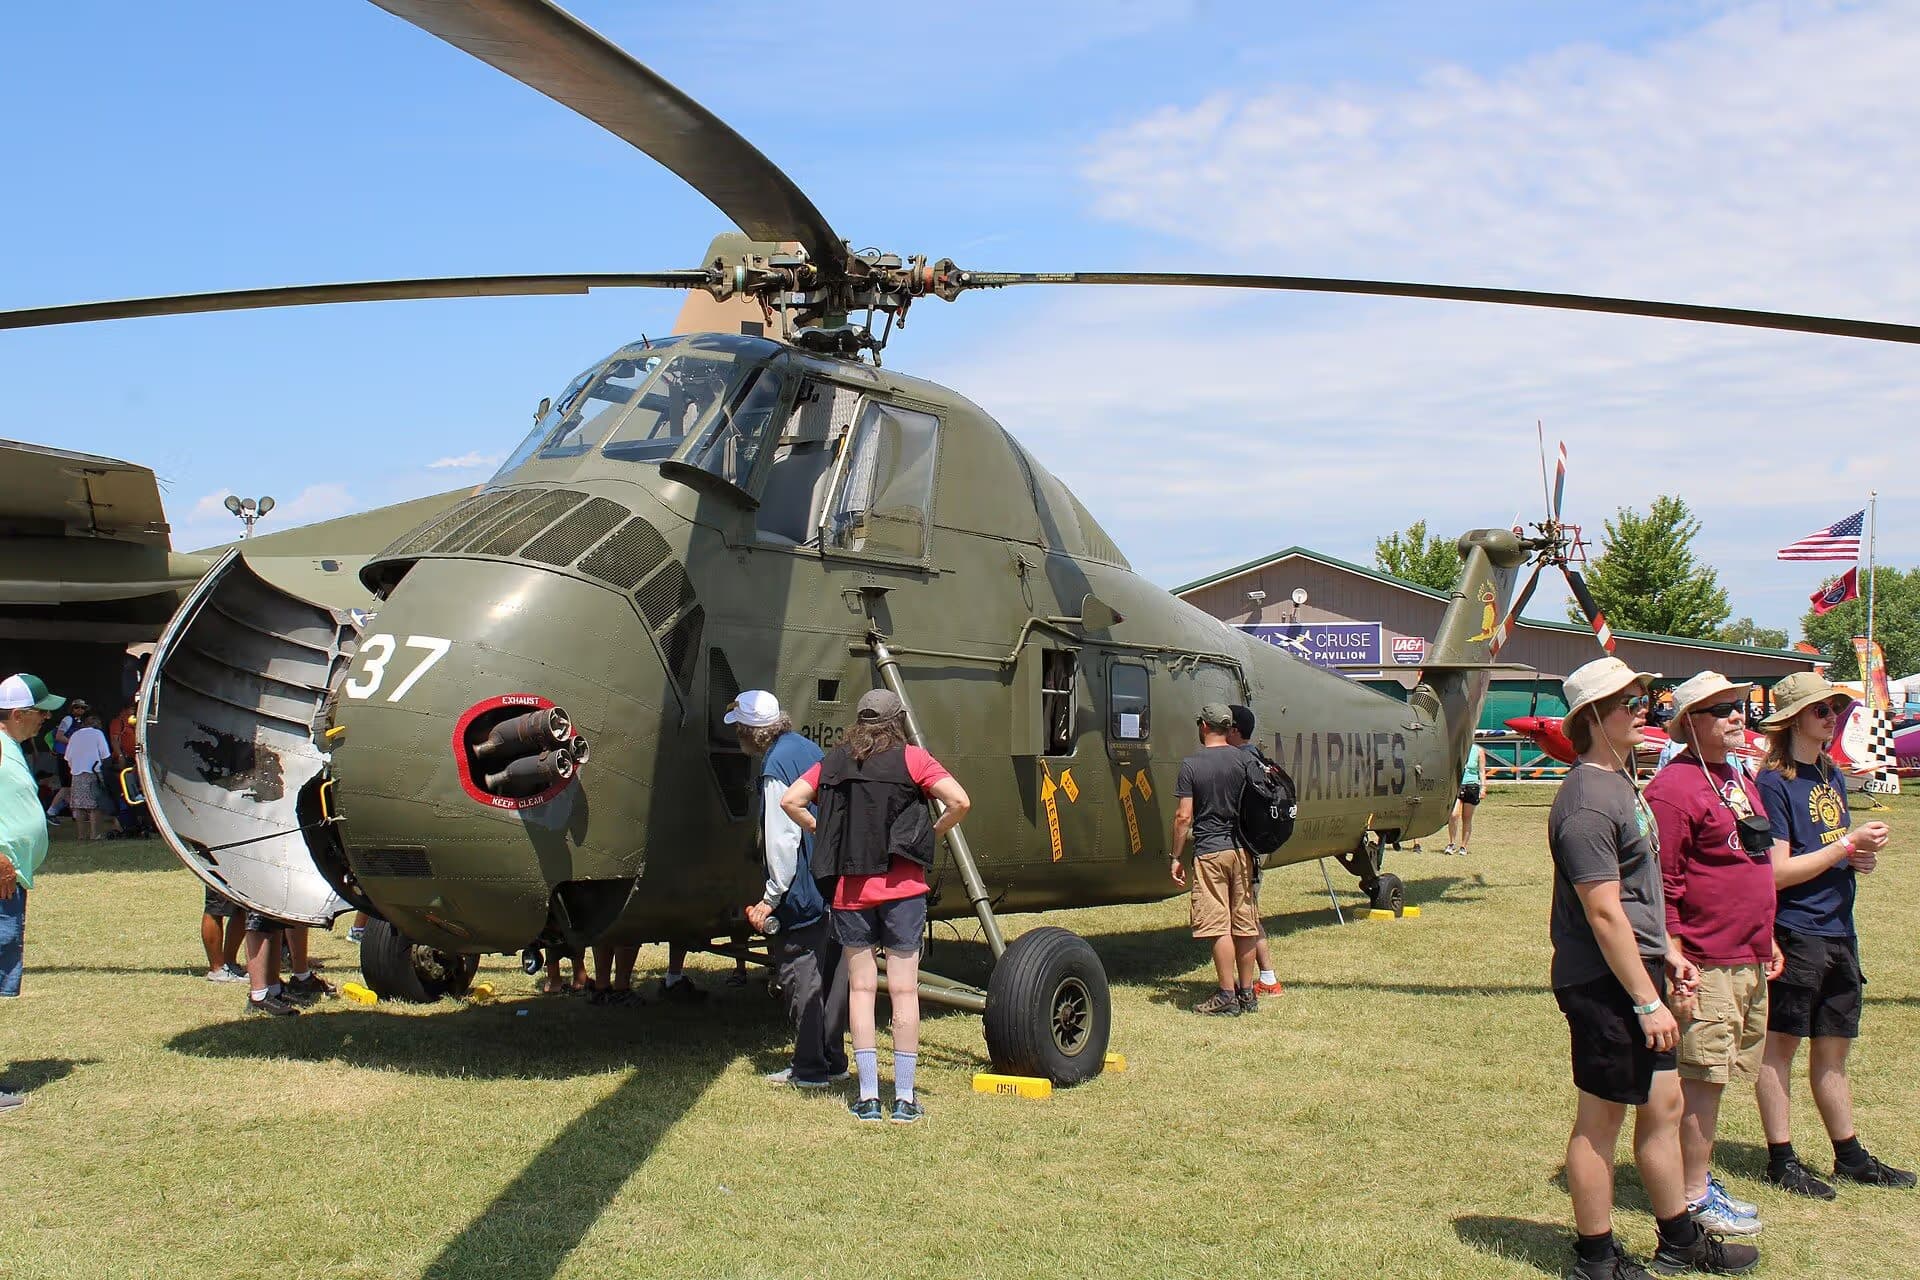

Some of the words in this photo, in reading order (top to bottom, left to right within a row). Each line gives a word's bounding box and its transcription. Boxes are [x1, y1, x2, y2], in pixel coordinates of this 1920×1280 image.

[1314, 651, 1366, 660] PAVILION
[1316, 633, 1371, 647] CRUSE
[345, 633, 452, 703] 37
[502, 696, 540, 705] EXHAUST
[1274, 732, 1406, 803] MARINES
[491, 797, 514, 808] KEEP
[1047, 798, 1062, 857] RESCUE
[1121, 794, 1141, 852] RESCUE
